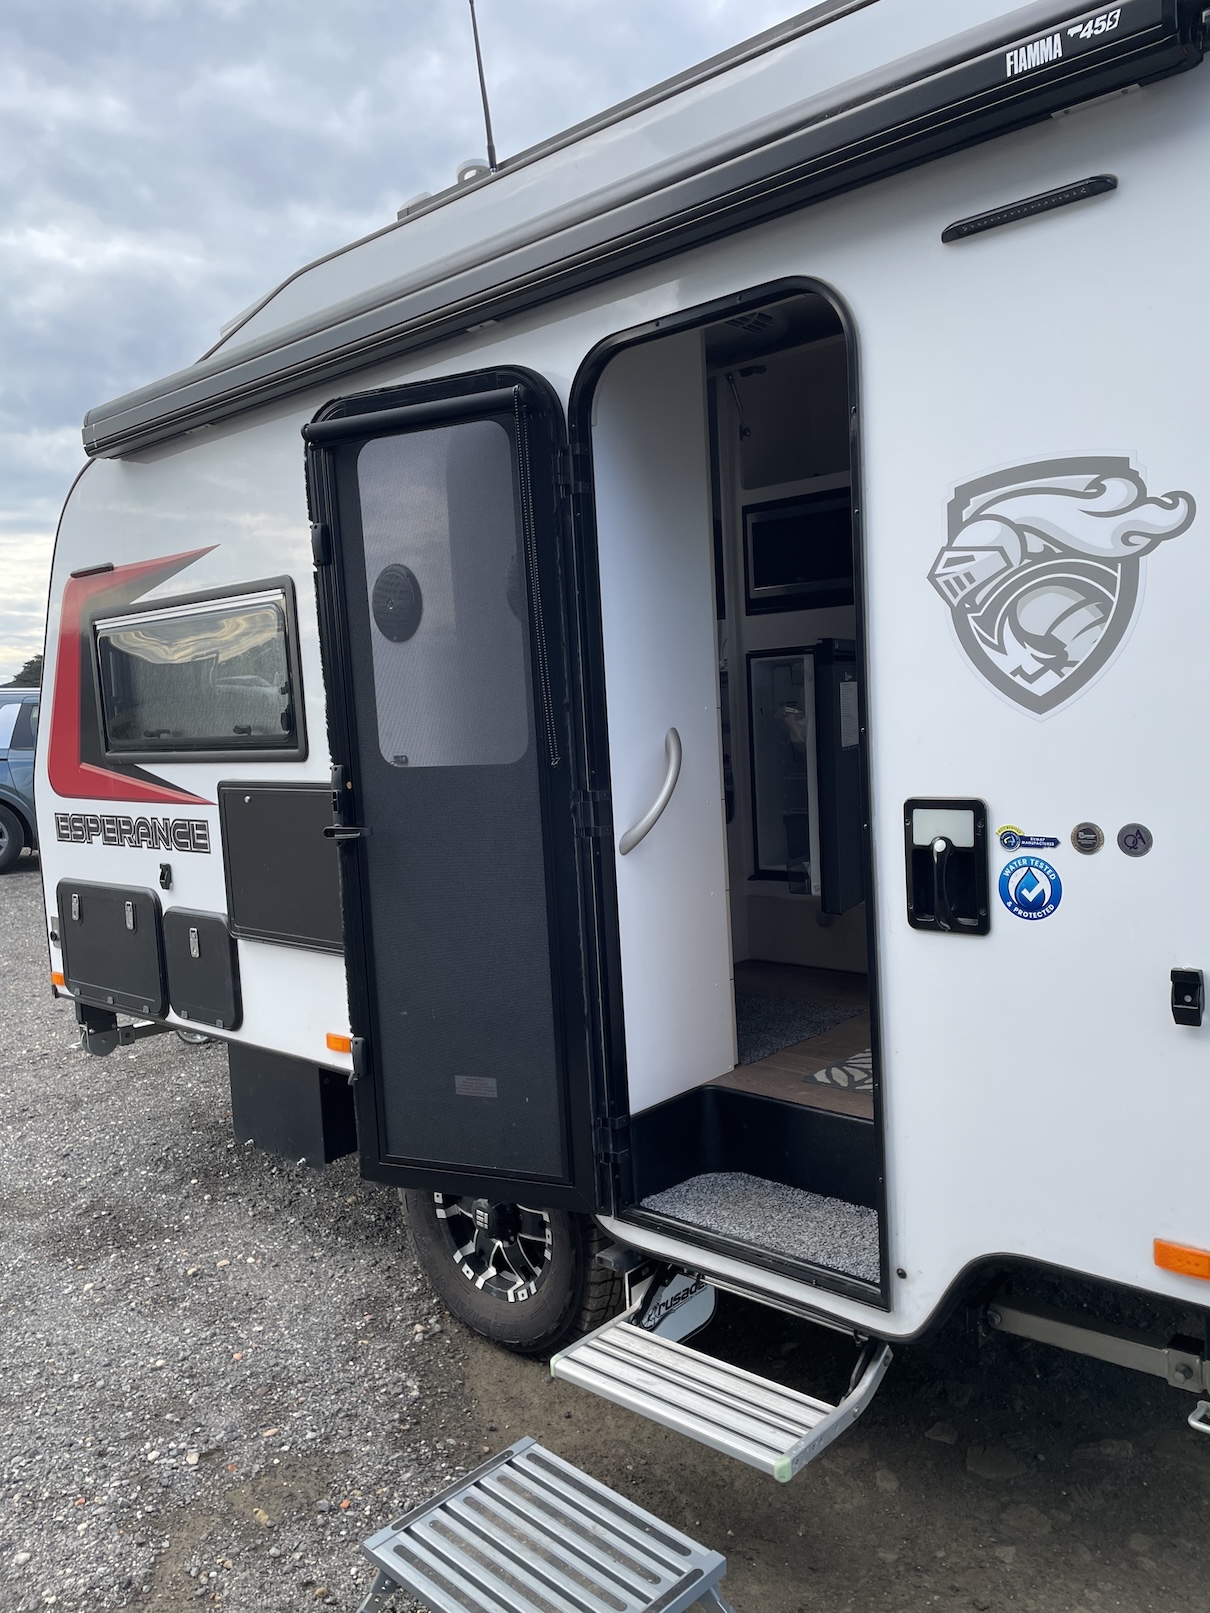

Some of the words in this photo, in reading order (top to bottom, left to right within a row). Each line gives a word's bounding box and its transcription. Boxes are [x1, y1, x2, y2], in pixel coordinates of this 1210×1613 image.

[1005, 32, 1063, 78] FIAMMA
[54, 812, 212, 854] ESPERANCE
[1123, 829, 1146, 850] QA
[1003, 858, 1028, 877] WATER
[1029, 858, 1056, 880] TESTED
[1012, 903, 1055, 919] PROTECTED
